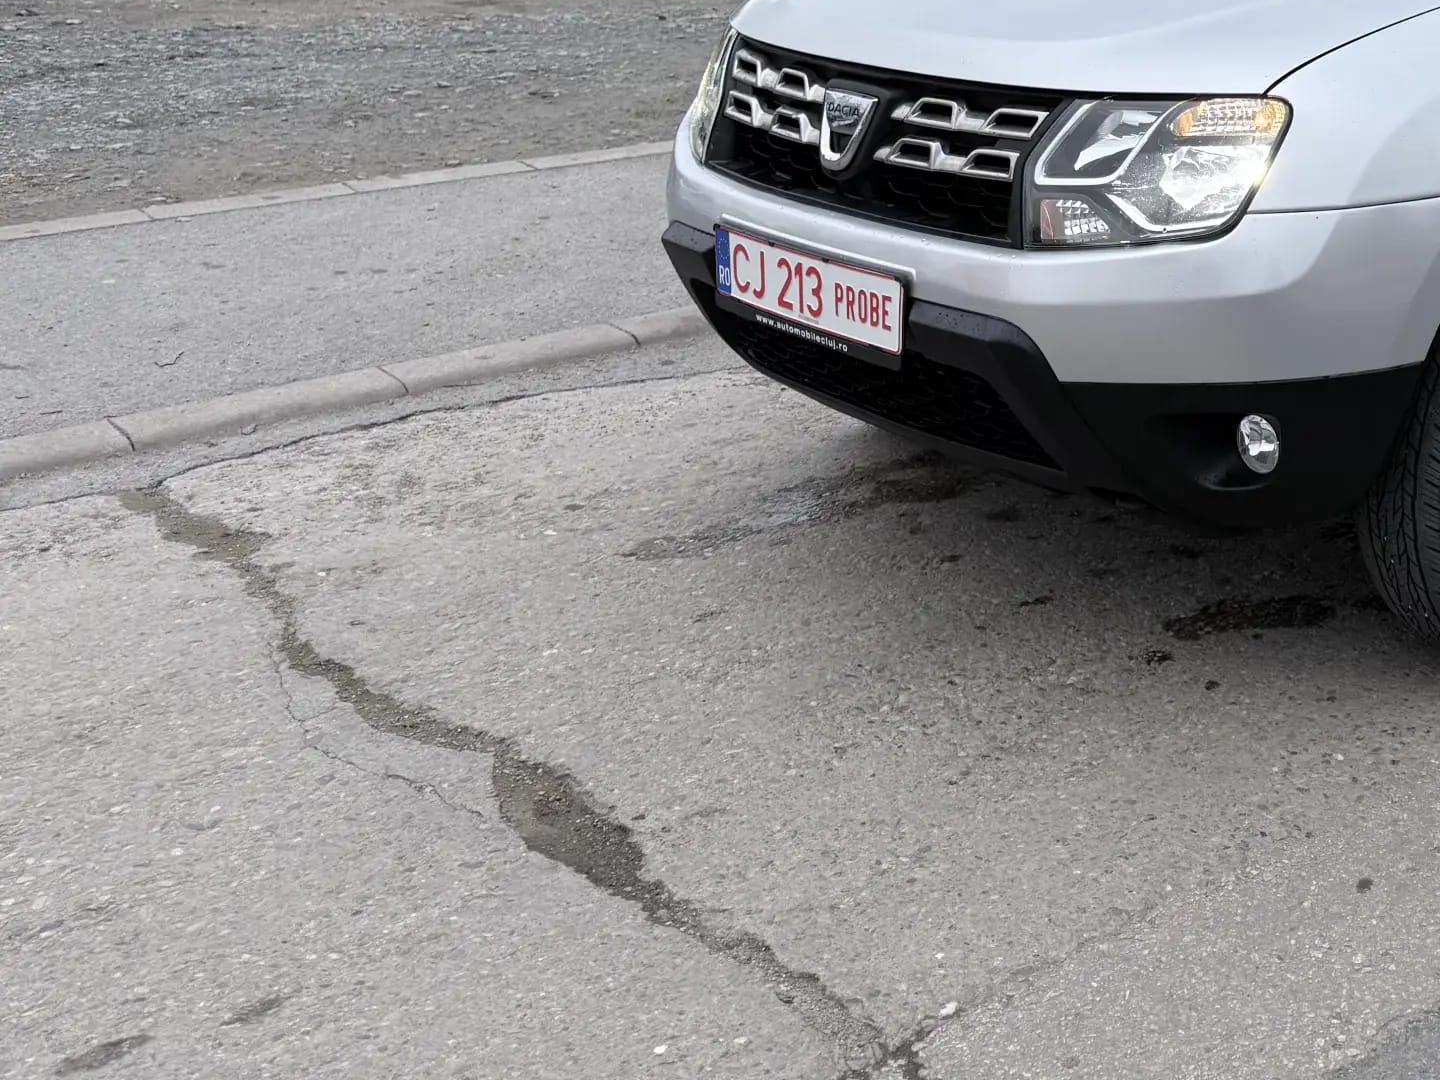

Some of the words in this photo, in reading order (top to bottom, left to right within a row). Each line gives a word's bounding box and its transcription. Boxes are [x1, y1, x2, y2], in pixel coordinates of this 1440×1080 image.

[827, 102, 861, 119] DACIA
[718, 264, 731, 288] RO
[732, 243, 767, 300] CJ
[776, 256, 824, 319] 213
[833, 281, 893, 332] PROBE
[755, 313, 849, 352] www.automobilecluj.ro
